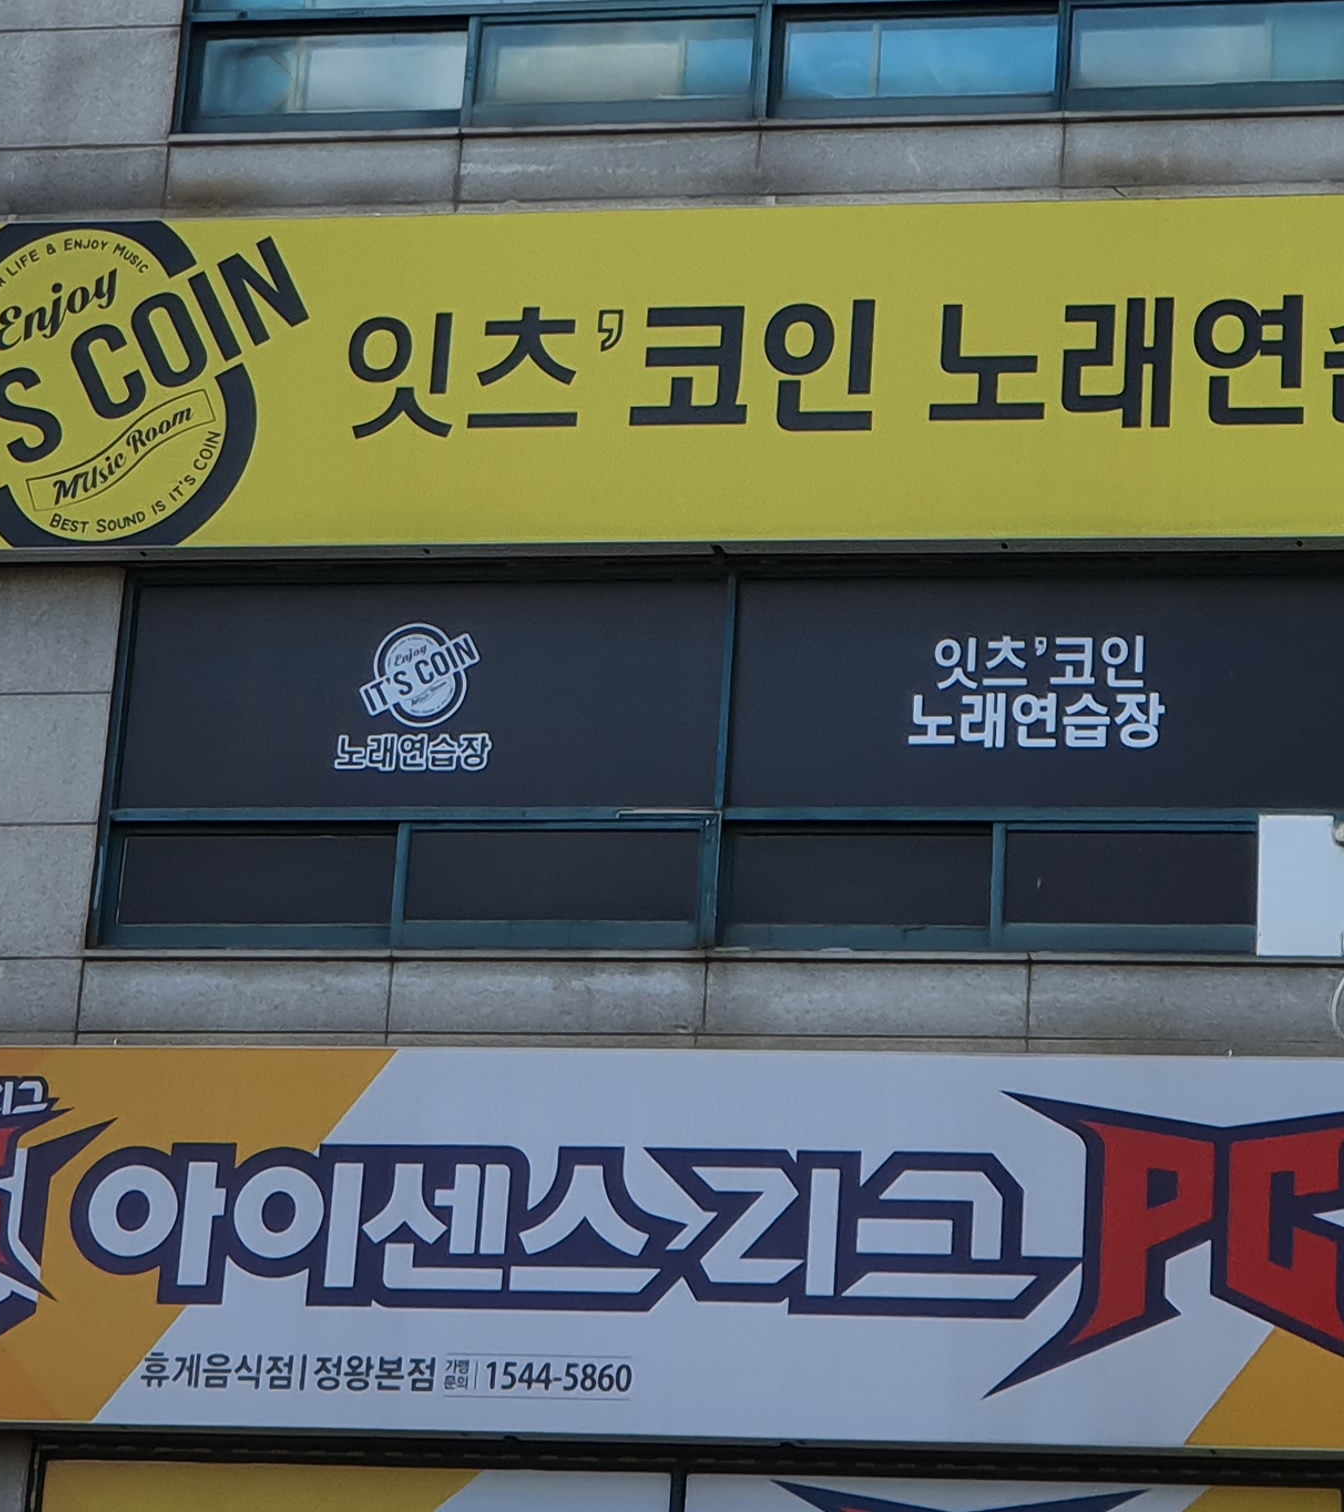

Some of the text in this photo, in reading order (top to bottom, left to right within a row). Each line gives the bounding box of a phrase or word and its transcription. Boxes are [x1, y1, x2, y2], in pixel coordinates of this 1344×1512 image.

[70, 235, 311, 420] COIN
[362, 669, 414, 713] IT'S
[414, 636, 478, 685] COIN
[907, 691, 1166, 749] 노래연습장
[334, 732, 494, 772] 노래연습장
[486, 1360, 633, 1393] 1544-5860
